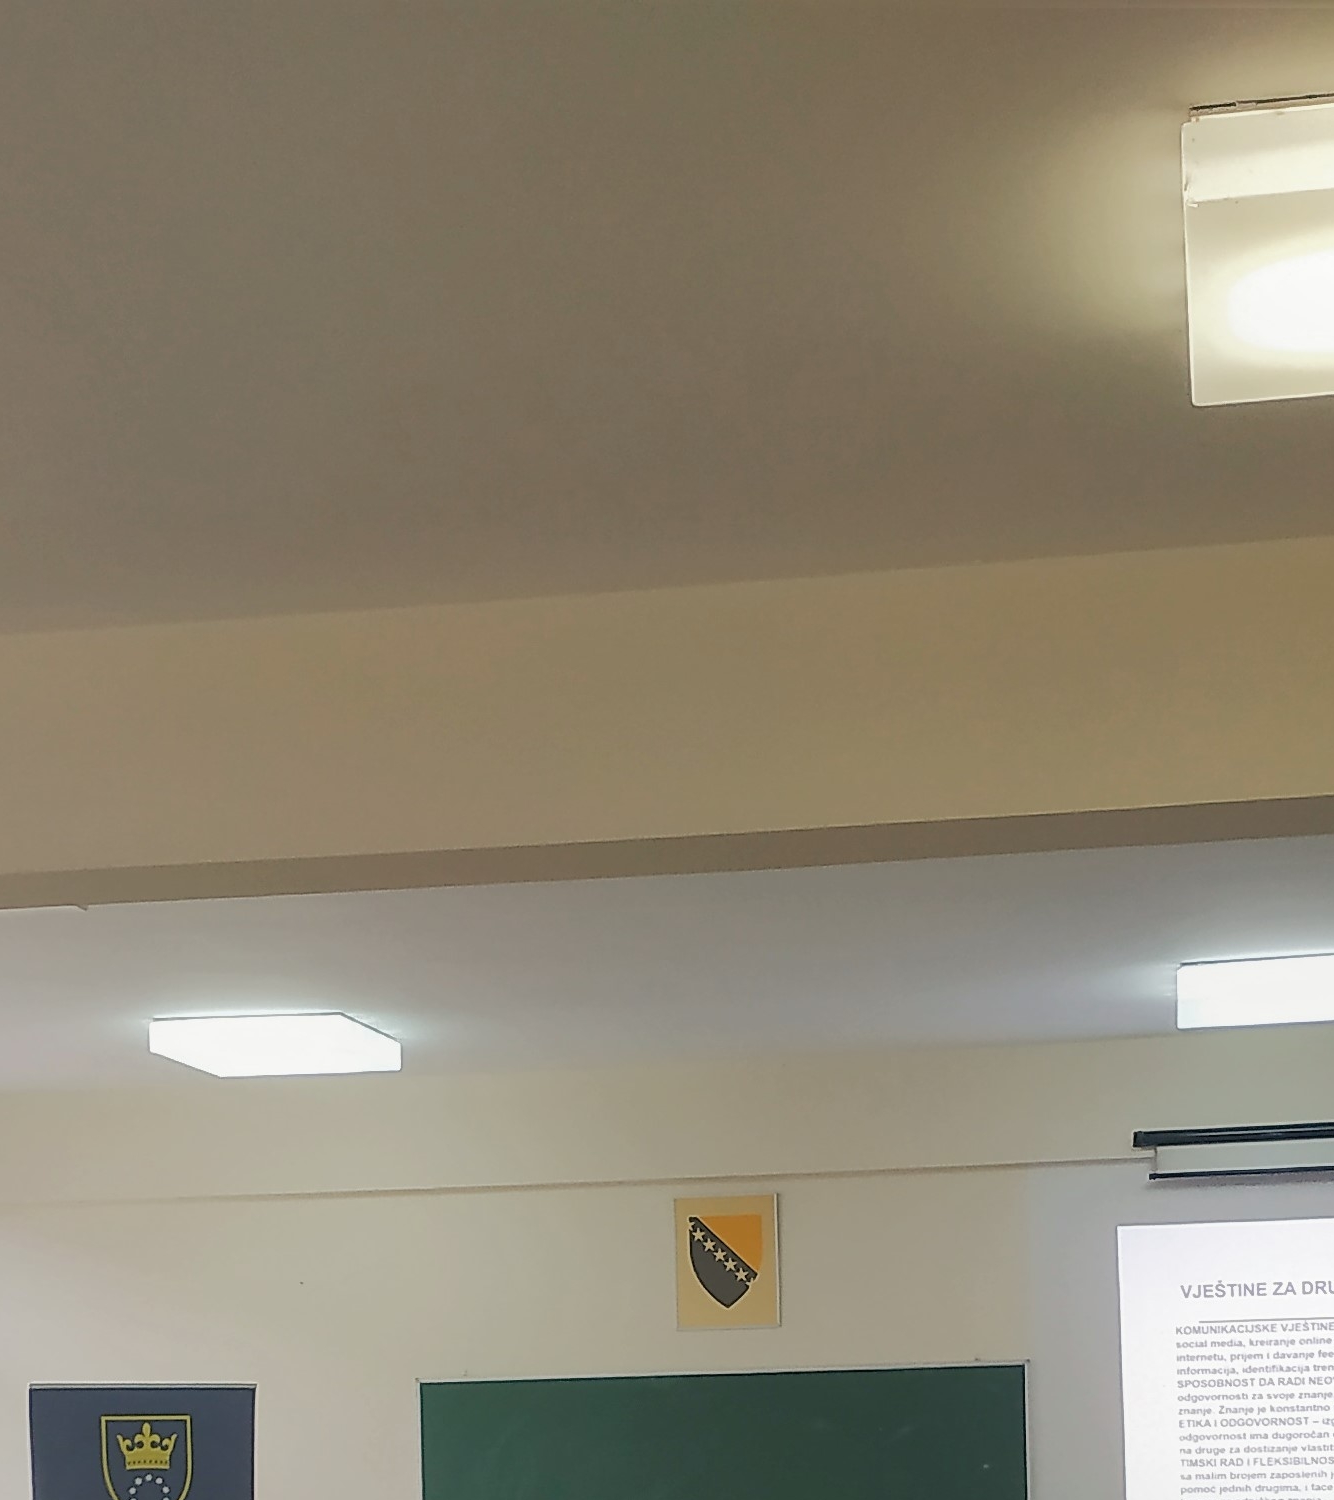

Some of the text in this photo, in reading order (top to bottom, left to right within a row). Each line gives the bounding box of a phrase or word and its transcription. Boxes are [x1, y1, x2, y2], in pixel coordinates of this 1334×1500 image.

[1181, 1280, 1267, 1298] VJEŠTINE
[1273, 1282, 1297, 1296] ZA
[1175, 1324, 1277, 1335] KOMUNIKACIJSKE
[1281, 1320, 1334, 1332] VJEŠTINE
[1175, 1340, 1207, 1349] social
[1211, 1338, 1246, 1348] media,
[1249, 1338, 1295, 1348] kreiranje
[1299, 1336, 1333, 1346] online
[1230, 1352, 1263, 1362] prijem
[1273, 1350, 1315, 1361] davanje
[1242, 1364, 1310, 1375] identifikacija
[1177, 1378, 1255, 1388] SPOSOBNOST
[1259, 1377, 1275, 1386] DA
[1277, 1376, 1305, 1386] RADI
[1177, 1392, 1249, 1404] odgovornosti
[1267, 1392, 1295, 1401] svoje
[1219, 1405, 1255, 1416] Znanje
[1257, 1405, 1267, 1416] je
[1269, 1403, 1331, 1413] konstantno
[1220, 1416, 1309, 1428] ODGOVORNOST
[1179, 1432, 1247, 1443] odgovornost
[1271, 1430, 1330, 1442] dugoročan
[1195, 1446, 1226, 1456] druge
[1243, 1444, 1297, 1454] dostizanje
[1181, 1458, 1217, 1468] TIMSKI
[1219, 1458, 1244, 1467] RAD
[1195, 1472, 1227, 1480] malim
[1229, 1472, 1267, 1481] brojem
[1269, 1470, 1327, 1480] zaposlenih
